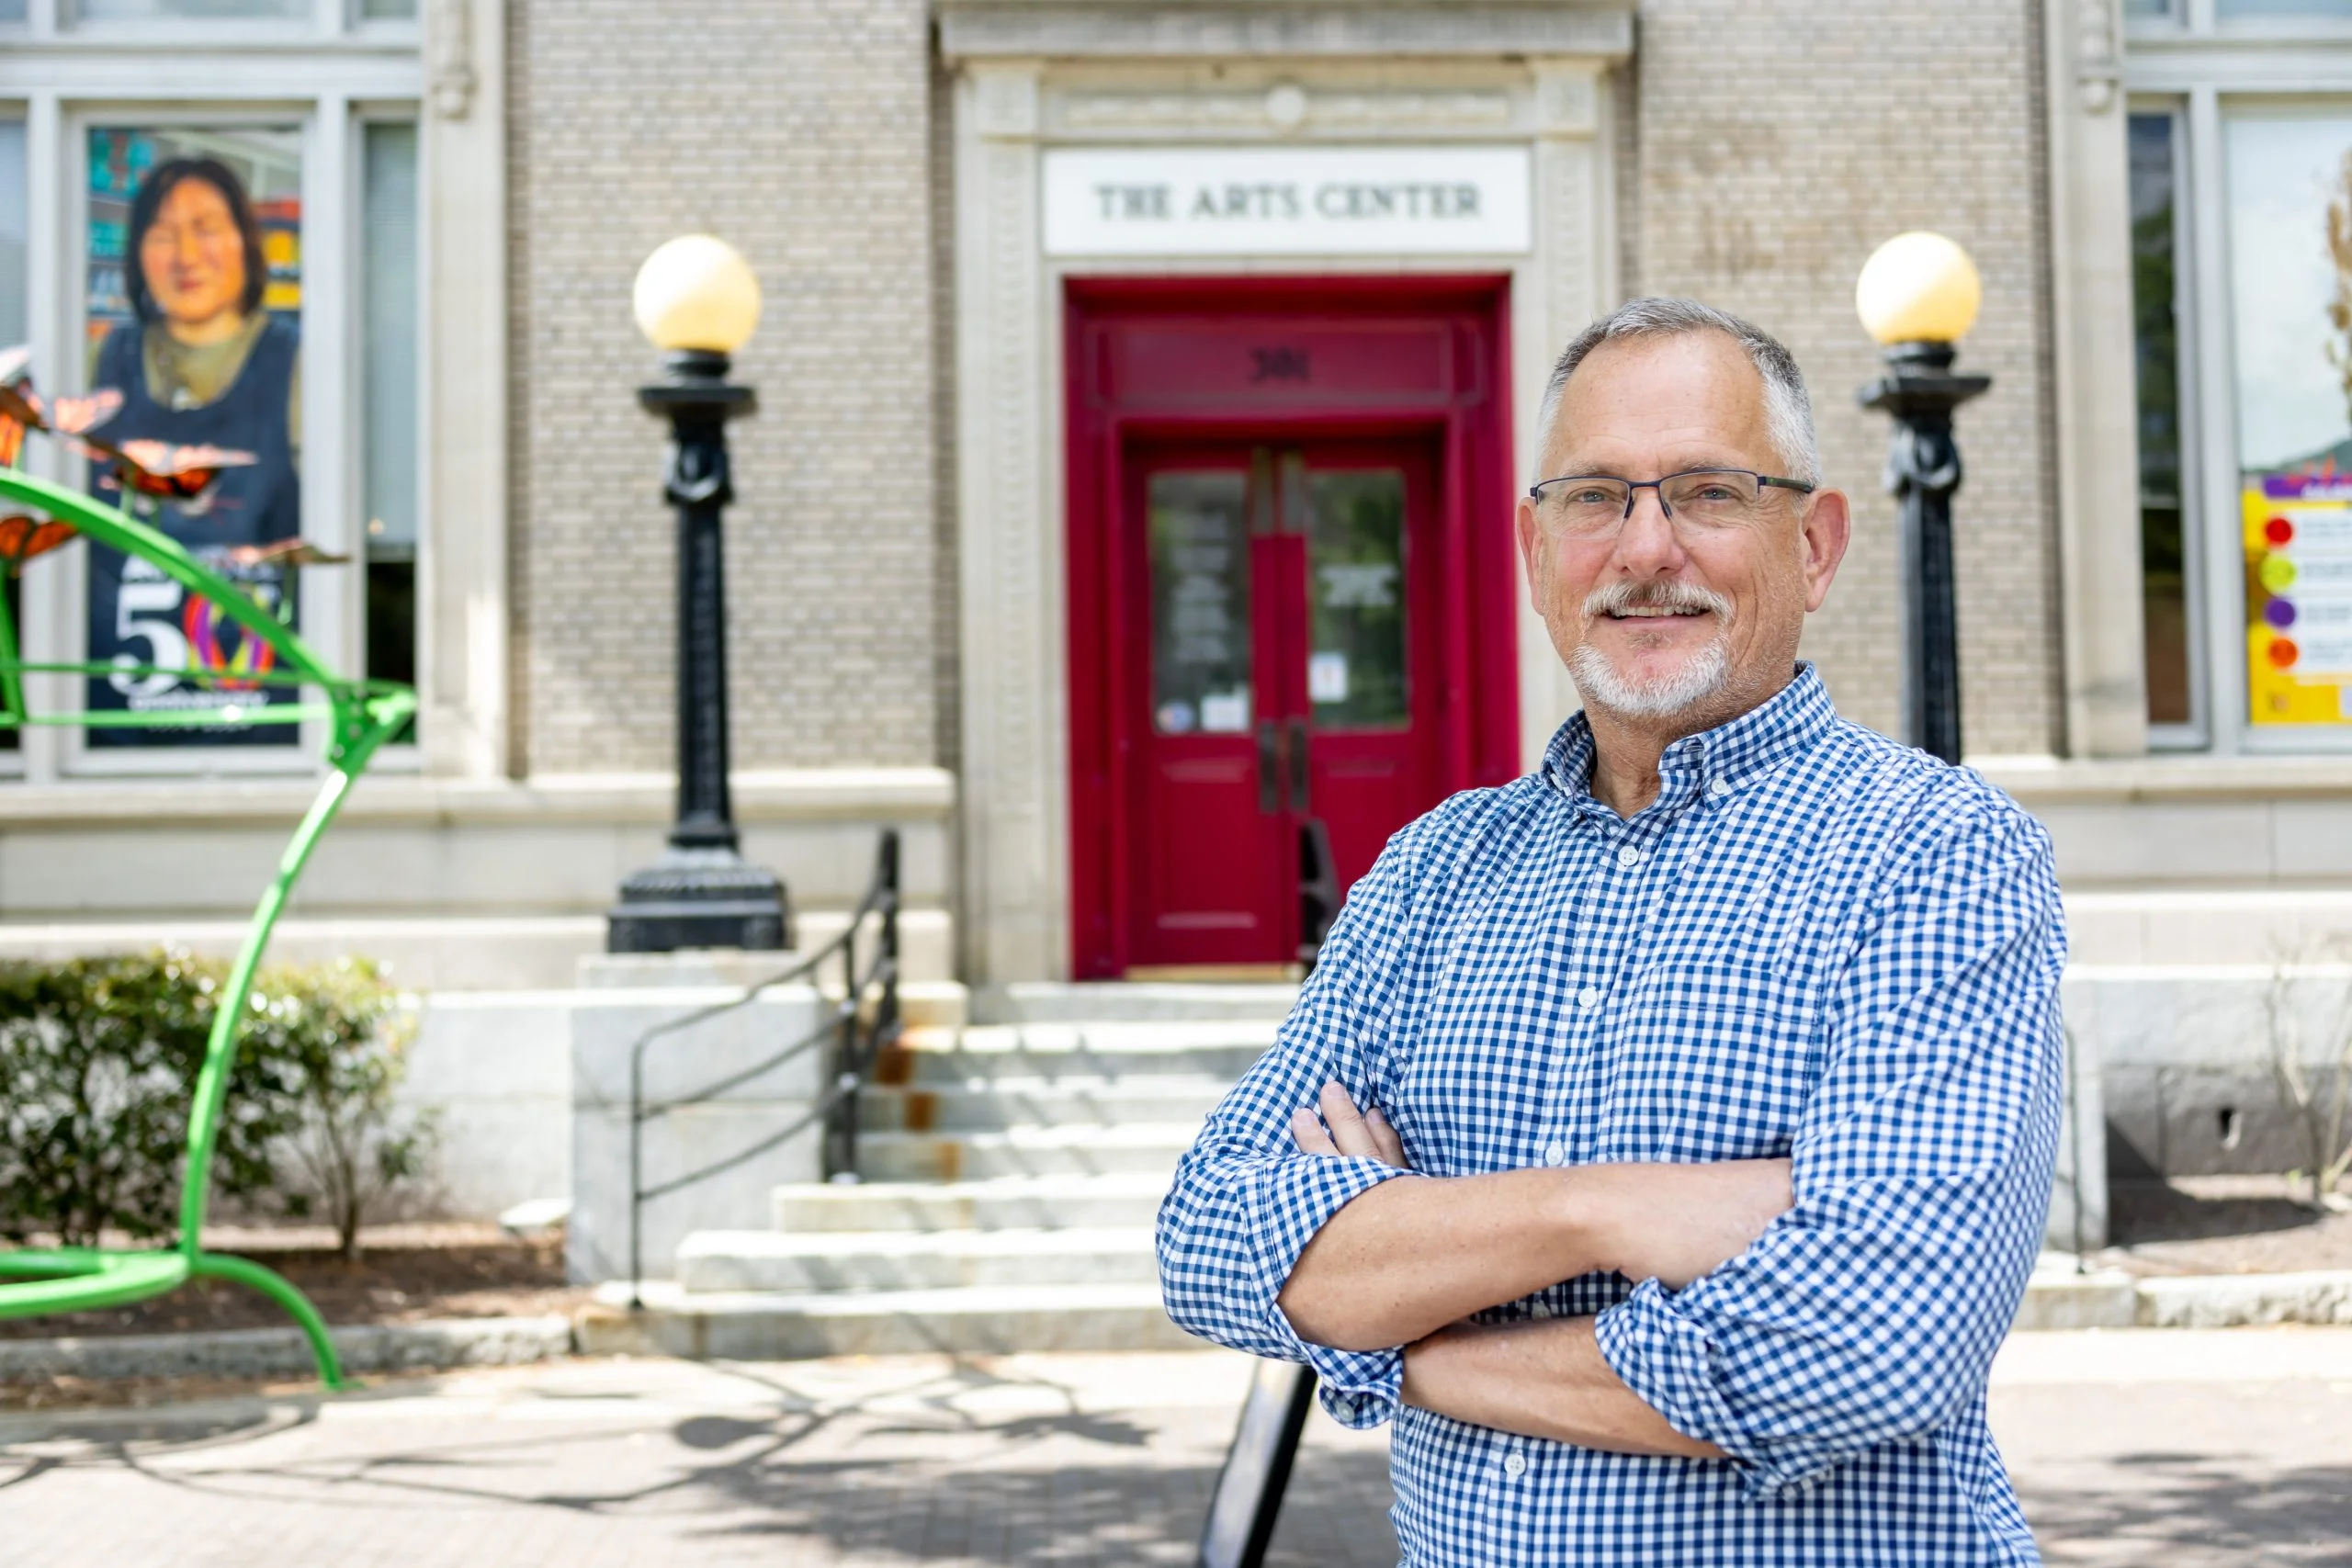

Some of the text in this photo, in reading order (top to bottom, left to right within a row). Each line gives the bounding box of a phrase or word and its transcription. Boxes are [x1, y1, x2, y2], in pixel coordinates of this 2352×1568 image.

[1097, 184, 1482, 218] THE ARTS CENTER
